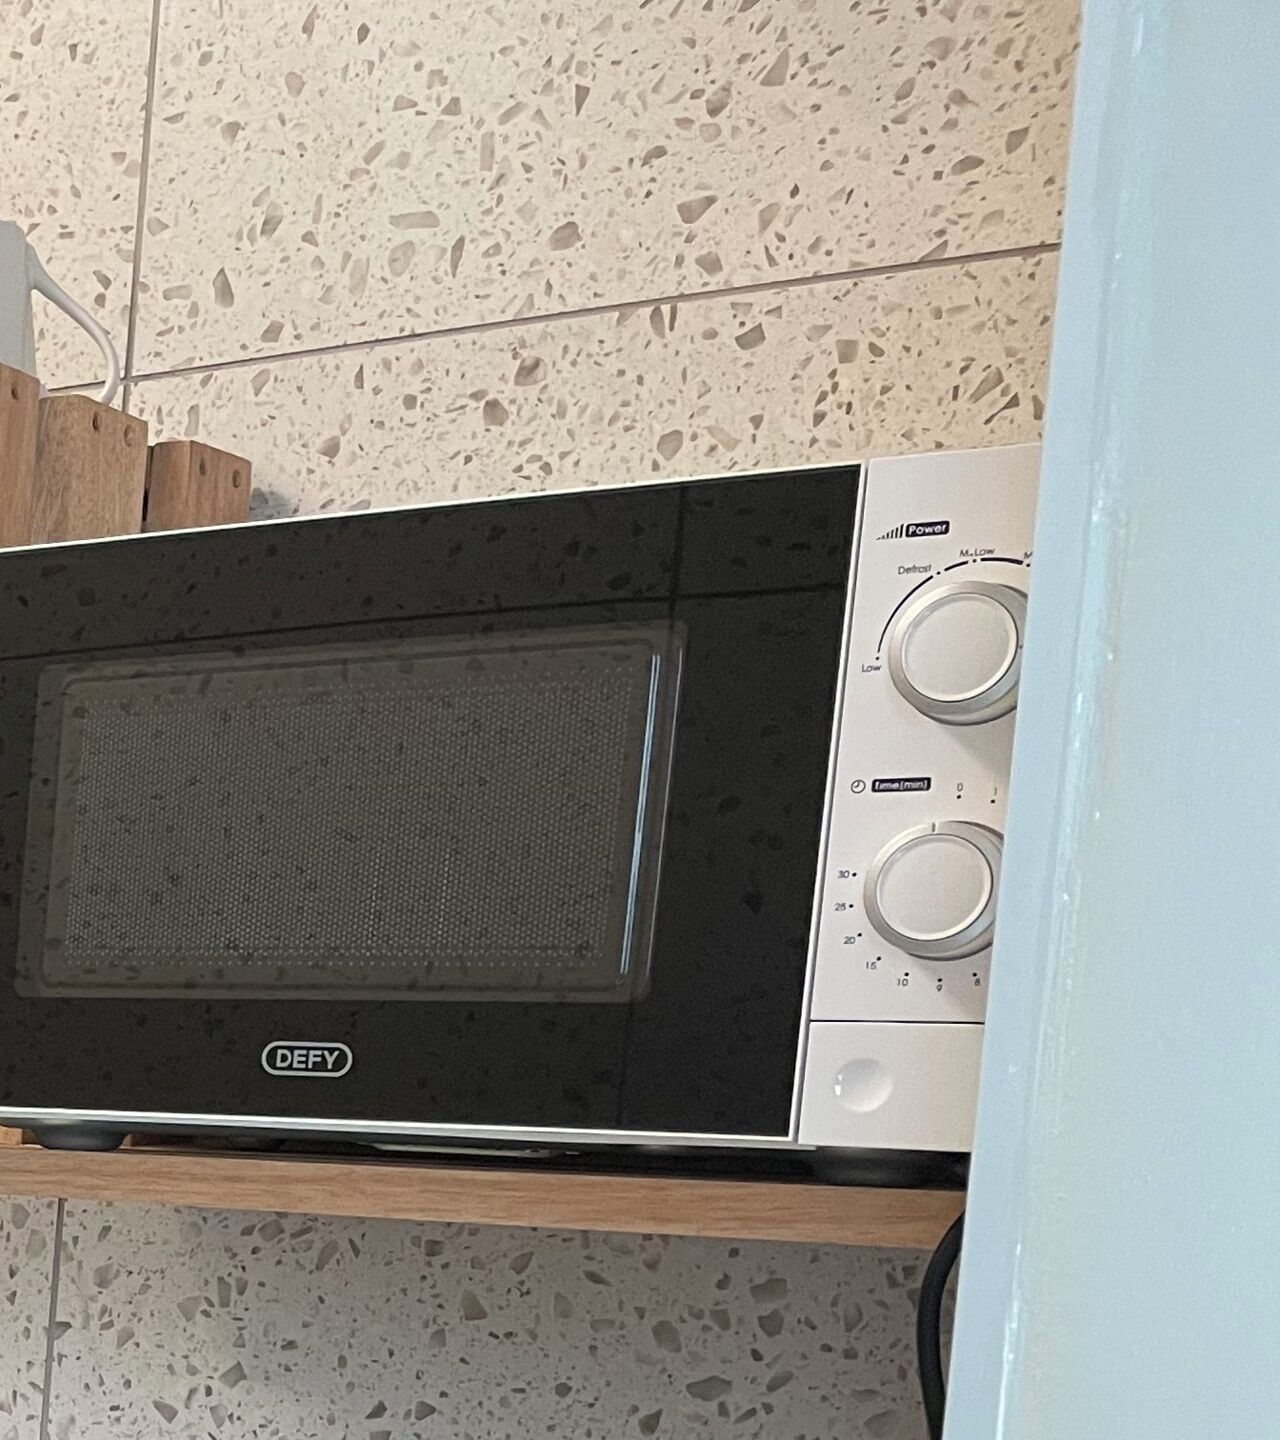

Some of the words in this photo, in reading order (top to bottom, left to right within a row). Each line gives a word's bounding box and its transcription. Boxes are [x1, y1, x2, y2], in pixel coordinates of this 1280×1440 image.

[907, 523, 947, 536] Power
[897, 564, 932, 575] Defrost
[861, 664, 882, 673] Low
[838, 870, 850, 879] 30
[834, 902, 847, 911] 25
[843, 936, 856, 945] 20
[865, 961, 877, 970] 15
[897, 978, 909, 987] 10
[275, 1048, 340, 1070] DEFY
